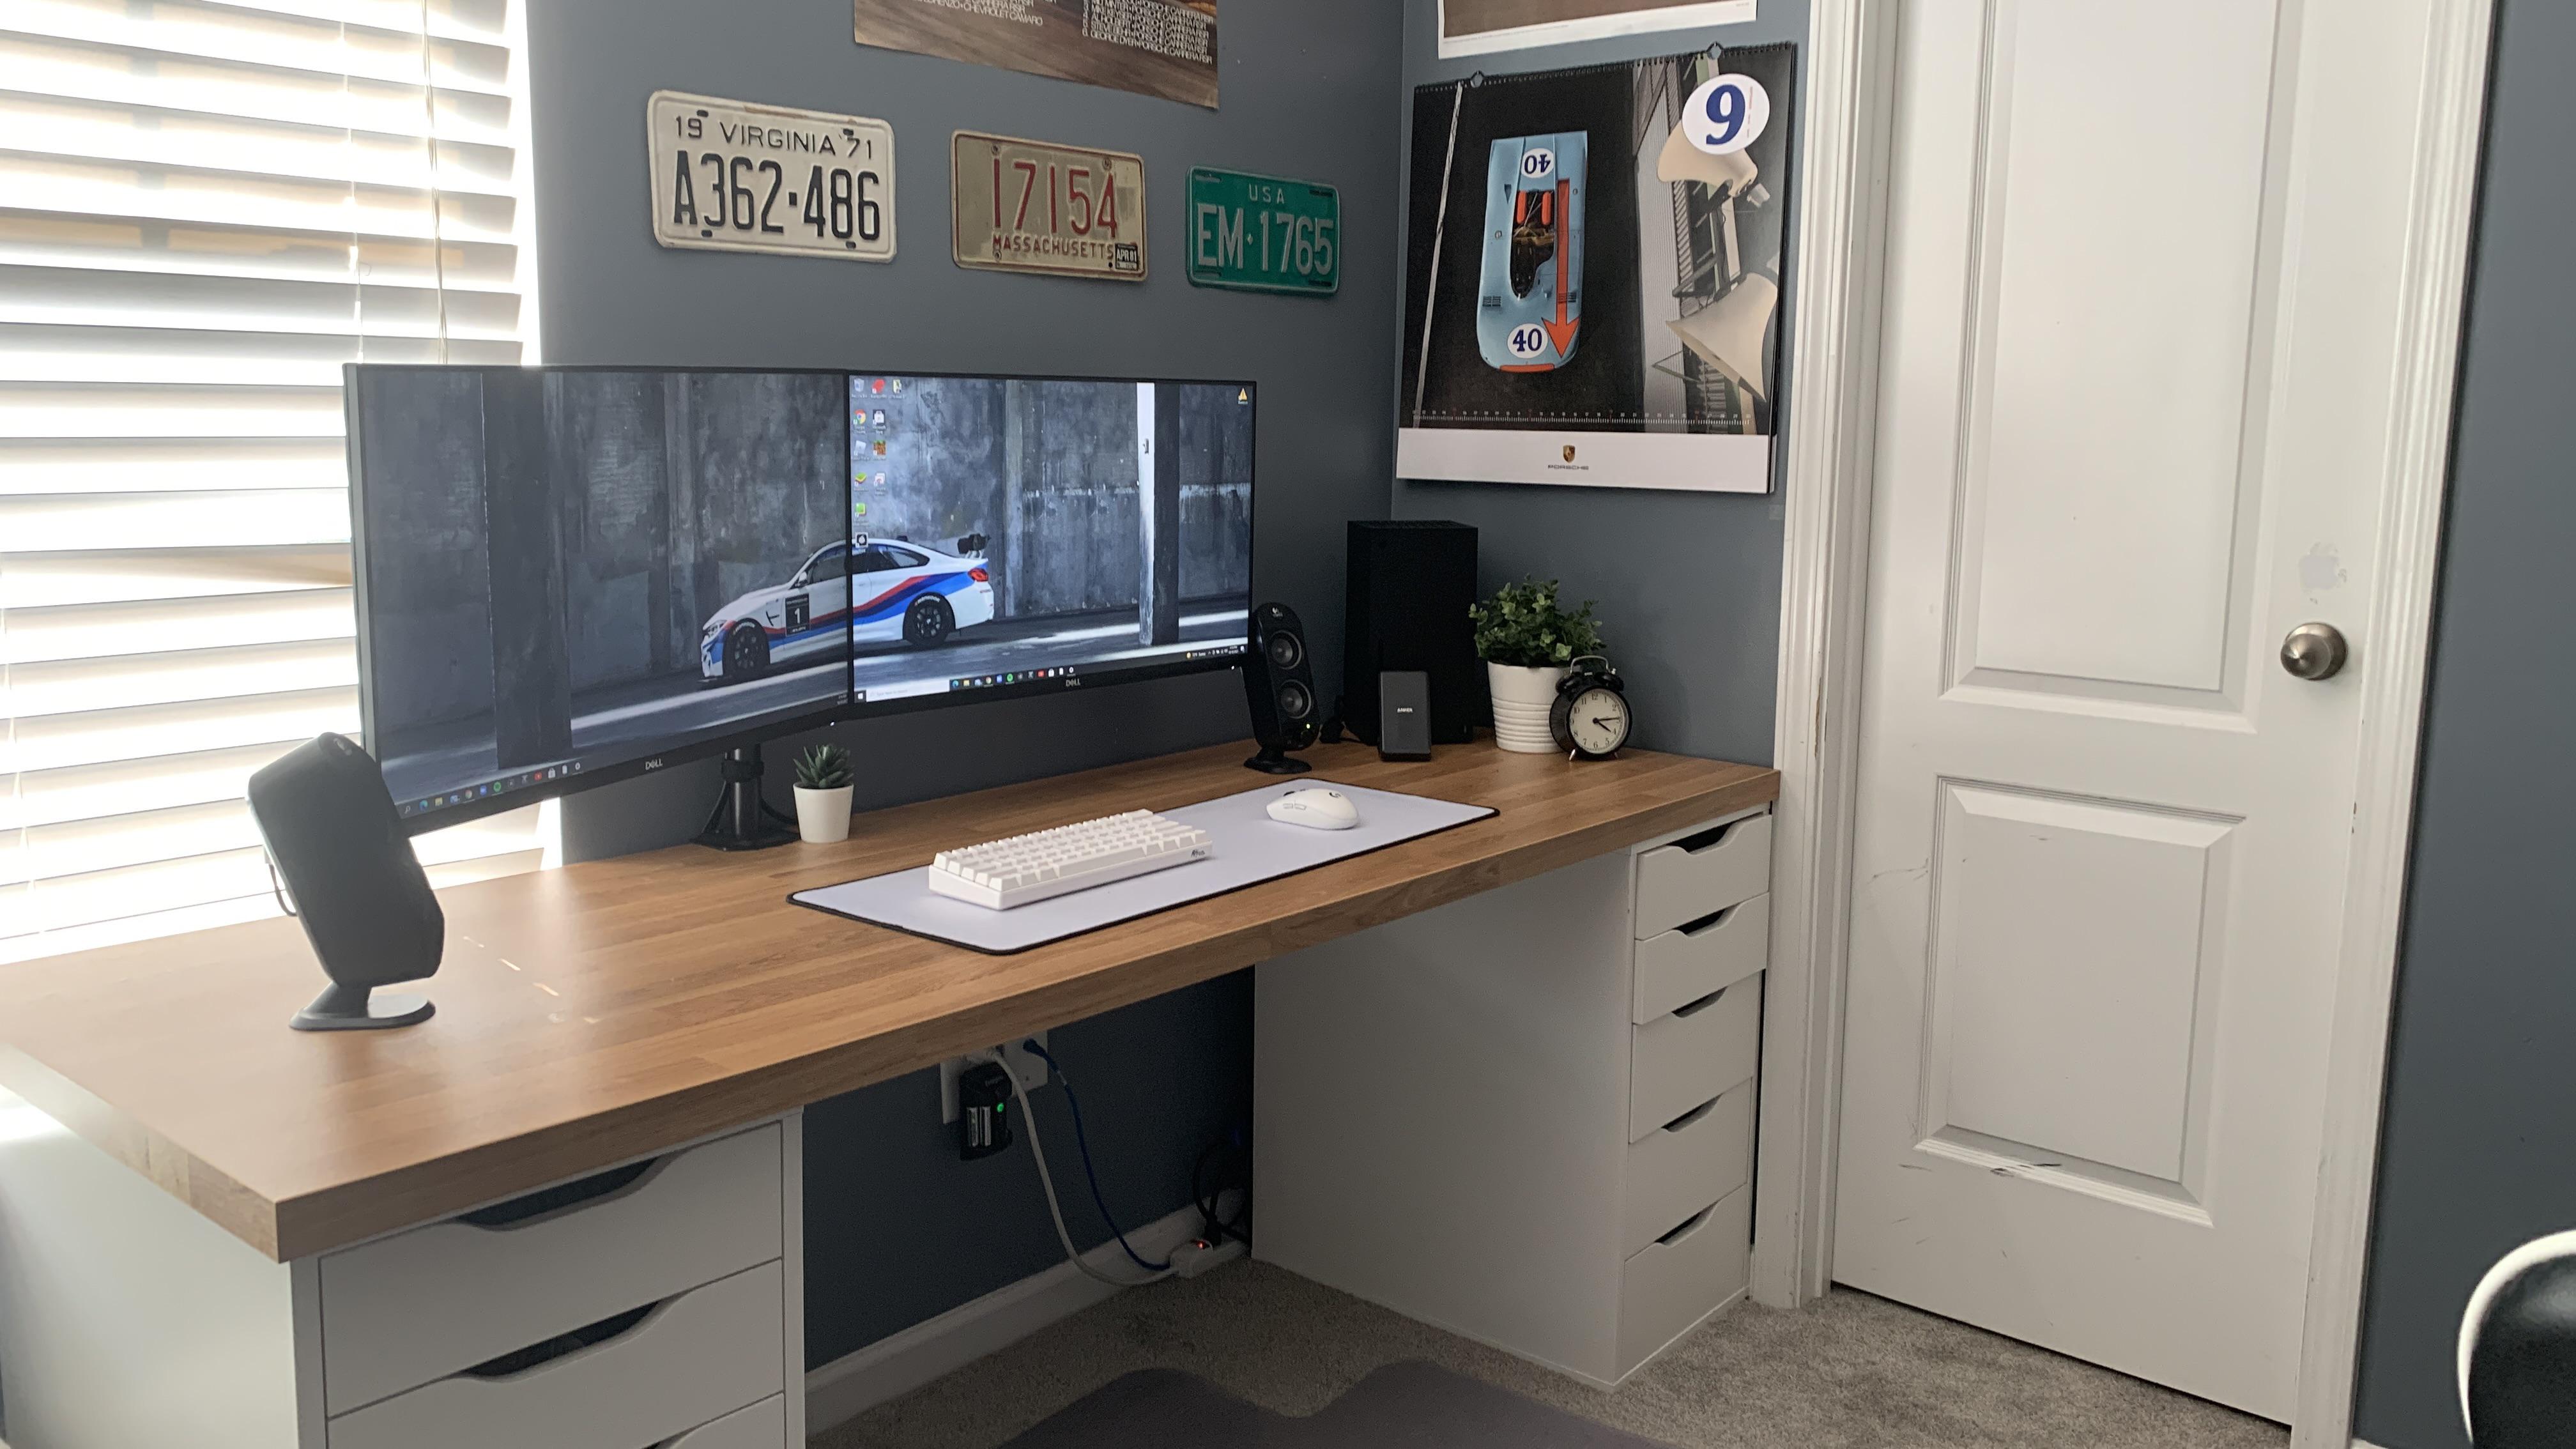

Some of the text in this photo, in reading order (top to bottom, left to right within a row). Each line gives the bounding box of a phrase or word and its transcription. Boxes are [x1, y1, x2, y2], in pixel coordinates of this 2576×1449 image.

[1706, 84, 1745, 145] 9
[675, 116, 702, 139] 19
[719, 121, 836, 156] VIRGINIA
[993, 158, 1117, 238] 17154
[1249, 183, 1284, 204] USA
[992, 235, 1114, 260] MASSACHUSETTS
[1116, 249, 1129, 261] APR
[1513, 328, 1542, 352] 40
[794, 608, 801, 624] 1
[1066, 678, 1081, 687] DELL
[645, 758, 663, 770] DELL
